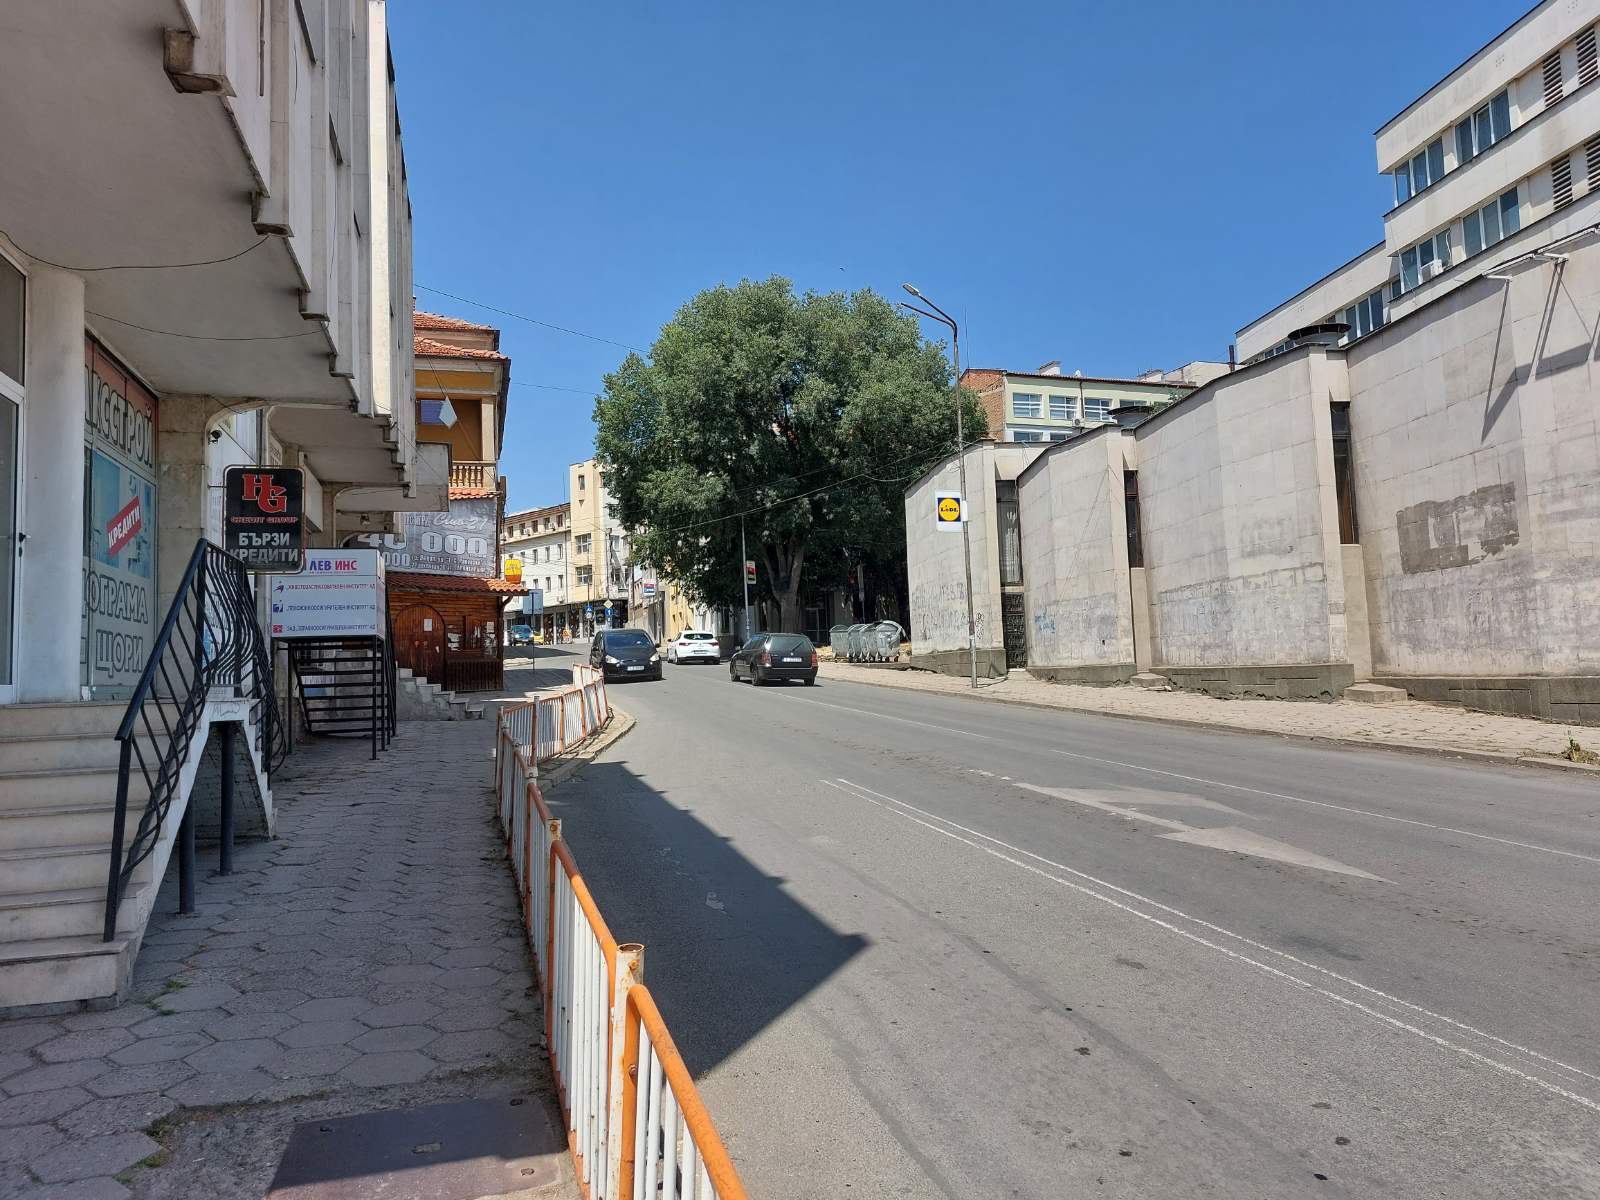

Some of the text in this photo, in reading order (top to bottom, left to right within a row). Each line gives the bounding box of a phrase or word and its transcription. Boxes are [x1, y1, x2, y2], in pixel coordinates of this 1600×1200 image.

[108, 505, 140, 548] КРЕДИТИ
[239, 532, 290, 546] БЪРЗИ
[309, 560, 358, 571] ЛЕВ ИНС
[96, 629, 143, 678] ЩОРИ
